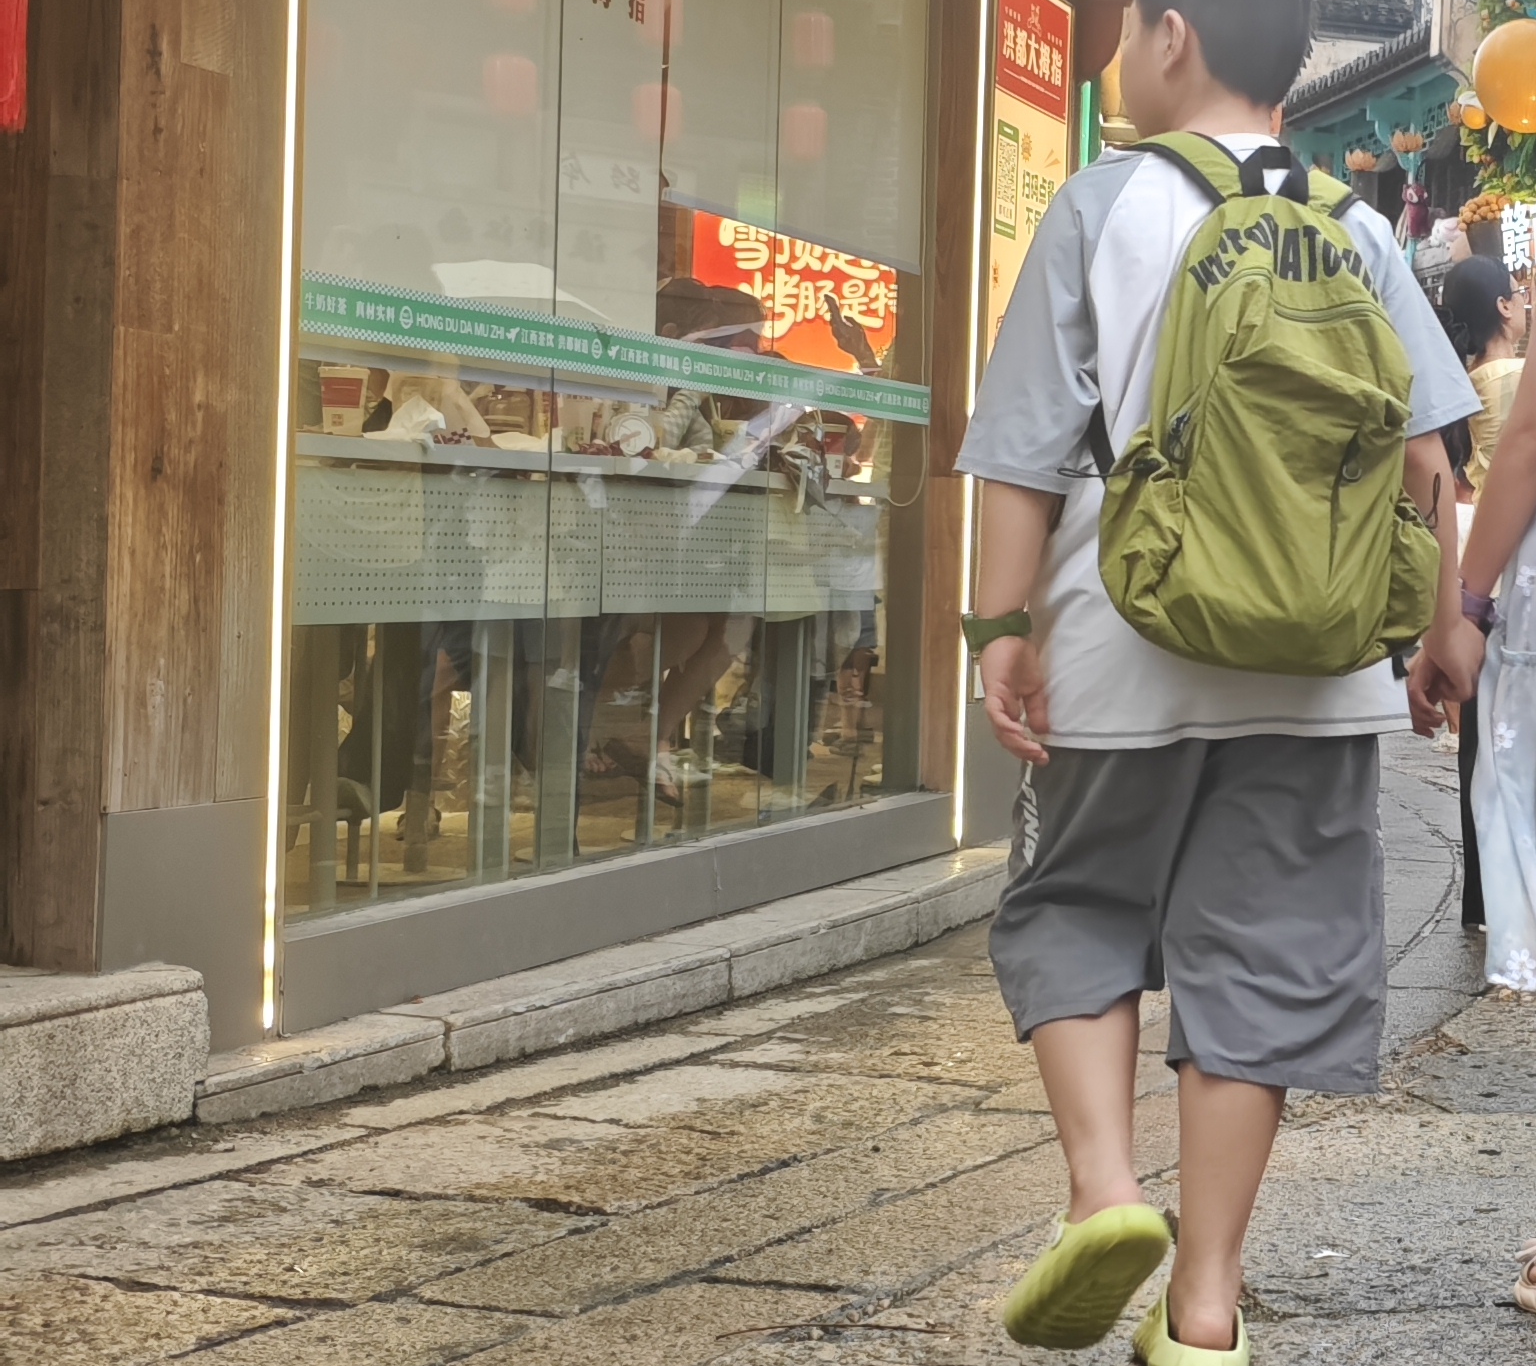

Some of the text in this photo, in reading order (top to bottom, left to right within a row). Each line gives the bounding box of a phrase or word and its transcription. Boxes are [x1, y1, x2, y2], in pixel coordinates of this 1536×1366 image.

[1002, 20, 1063, 88] 洪都大拇指
[305, 291, 348, 316] 牛奶好茶
[355, 300, 396, 324] 真材实料
[416, 312, 444, 331] HONG
[445, 316, 459, 333] DU
[460, 319, 473, 335] DA
[474, 321, 489, 337] MU
[490, 324, 505, 340] ZHI
[693, 361, 713, 376] HONG
